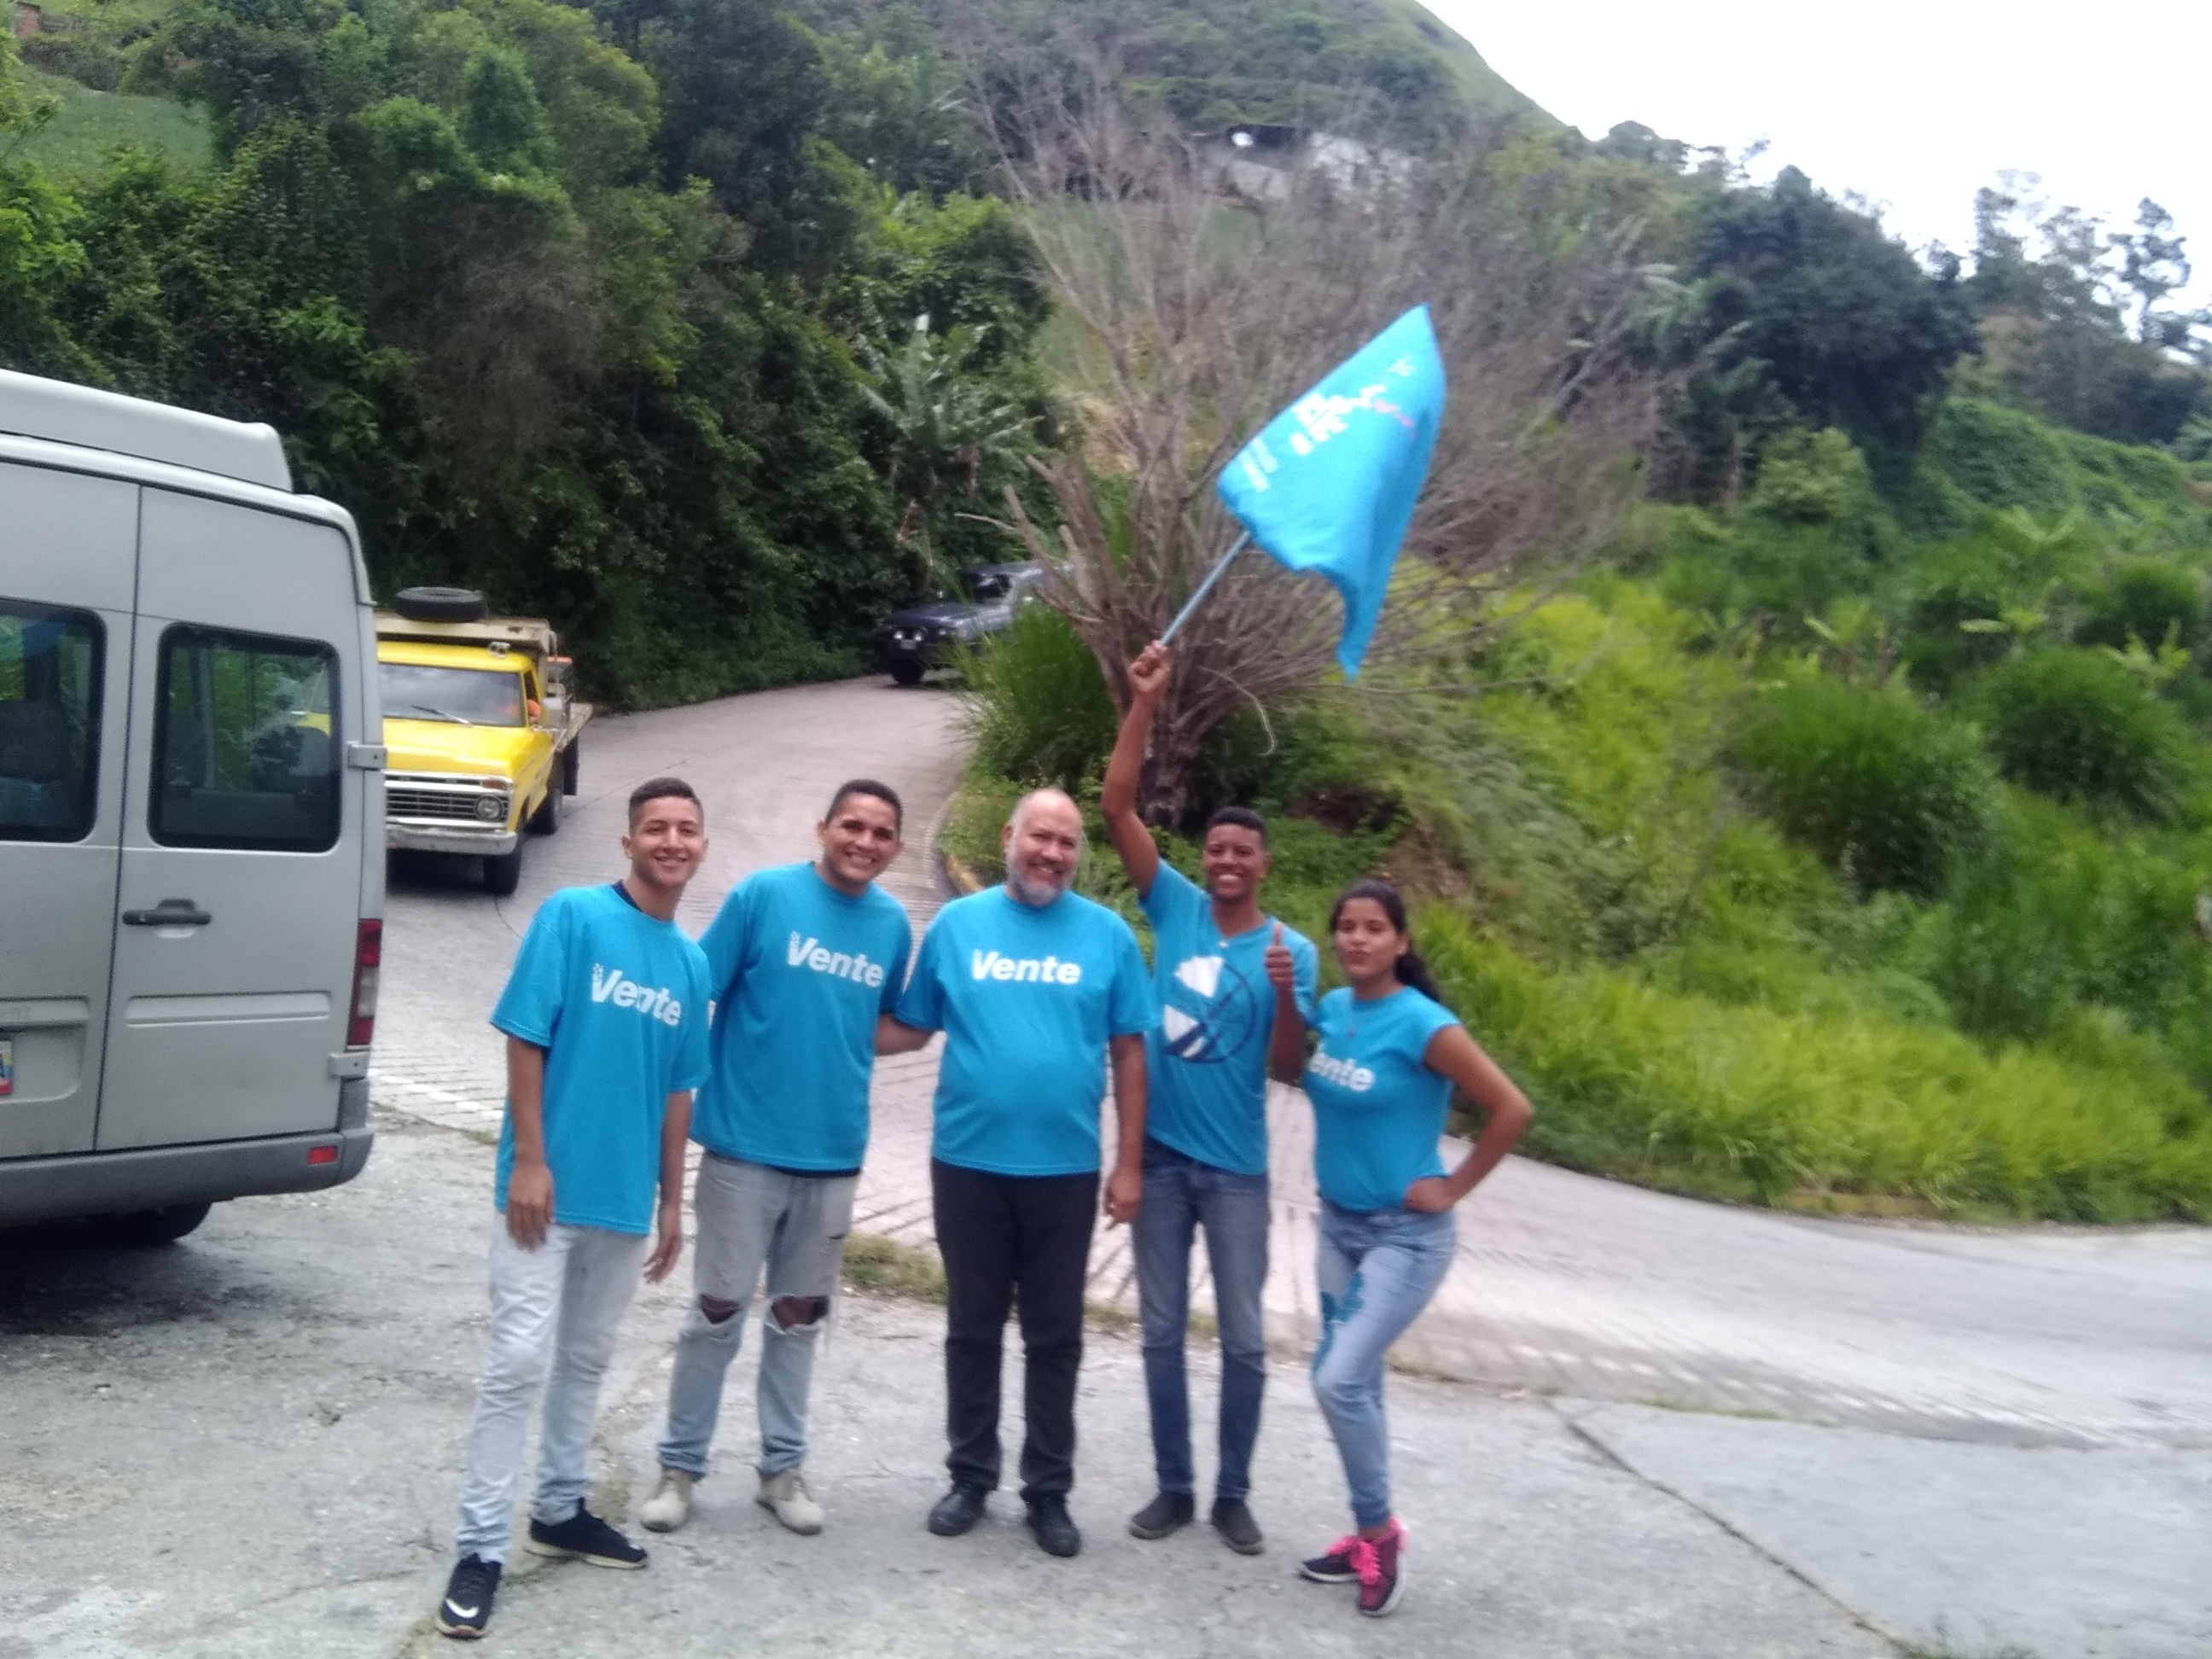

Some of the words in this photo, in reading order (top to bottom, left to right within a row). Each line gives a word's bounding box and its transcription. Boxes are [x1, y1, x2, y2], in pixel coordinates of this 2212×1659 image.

[786, 931, 884, 987] Vente
[972, 949, 1081, 984] Vente
[591, 963, 681, 1026] Vente
[1310, 1039, 1375, 1091] ente
